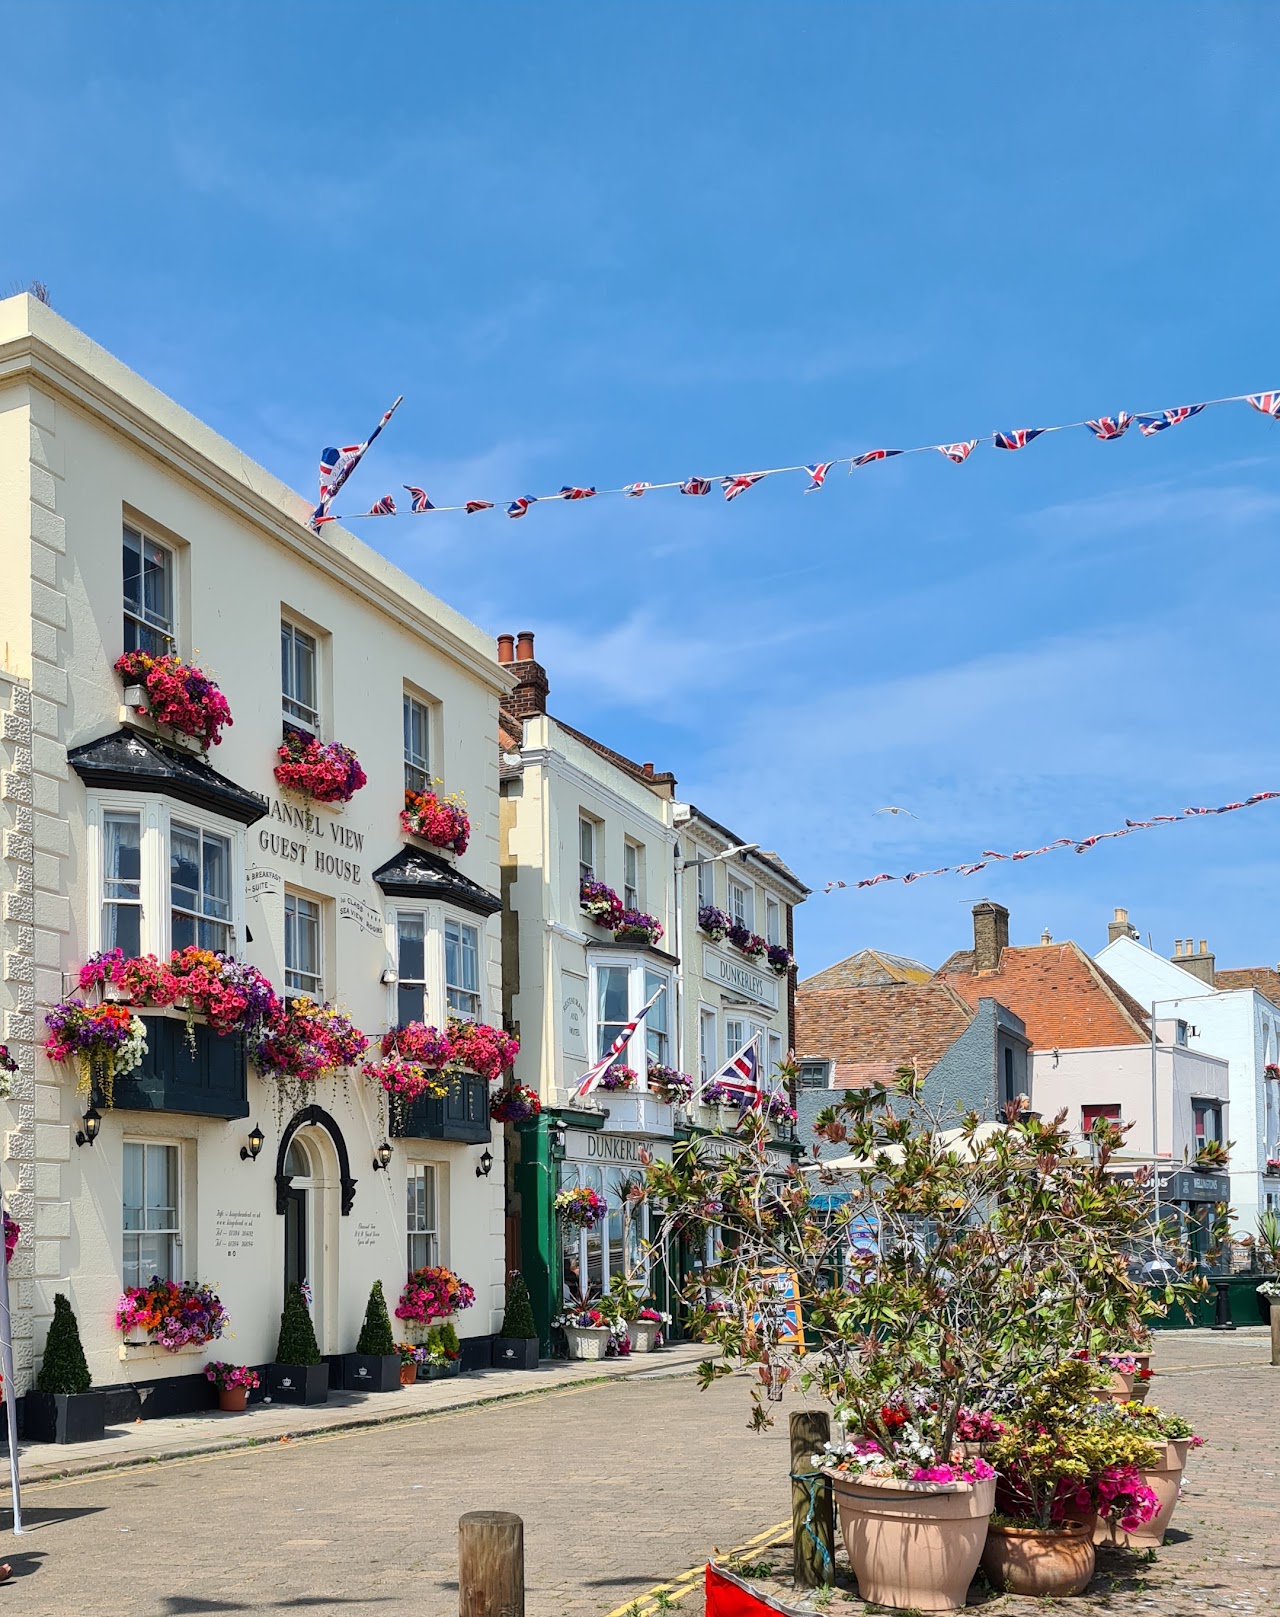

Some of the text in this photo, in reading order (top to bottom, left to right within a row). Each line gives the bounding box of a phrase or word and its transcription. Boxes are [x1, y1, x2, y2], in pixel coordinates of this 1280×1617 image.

[329, 822, 364, 853] VIEW
[259, 829, 361, 886] GUEST HOUSE
[251, 871, 281, 882] BREAKFAST
[351, 909, 363, 922] VIEW
[720, 960, 763, 996] DUNKERLEYS
